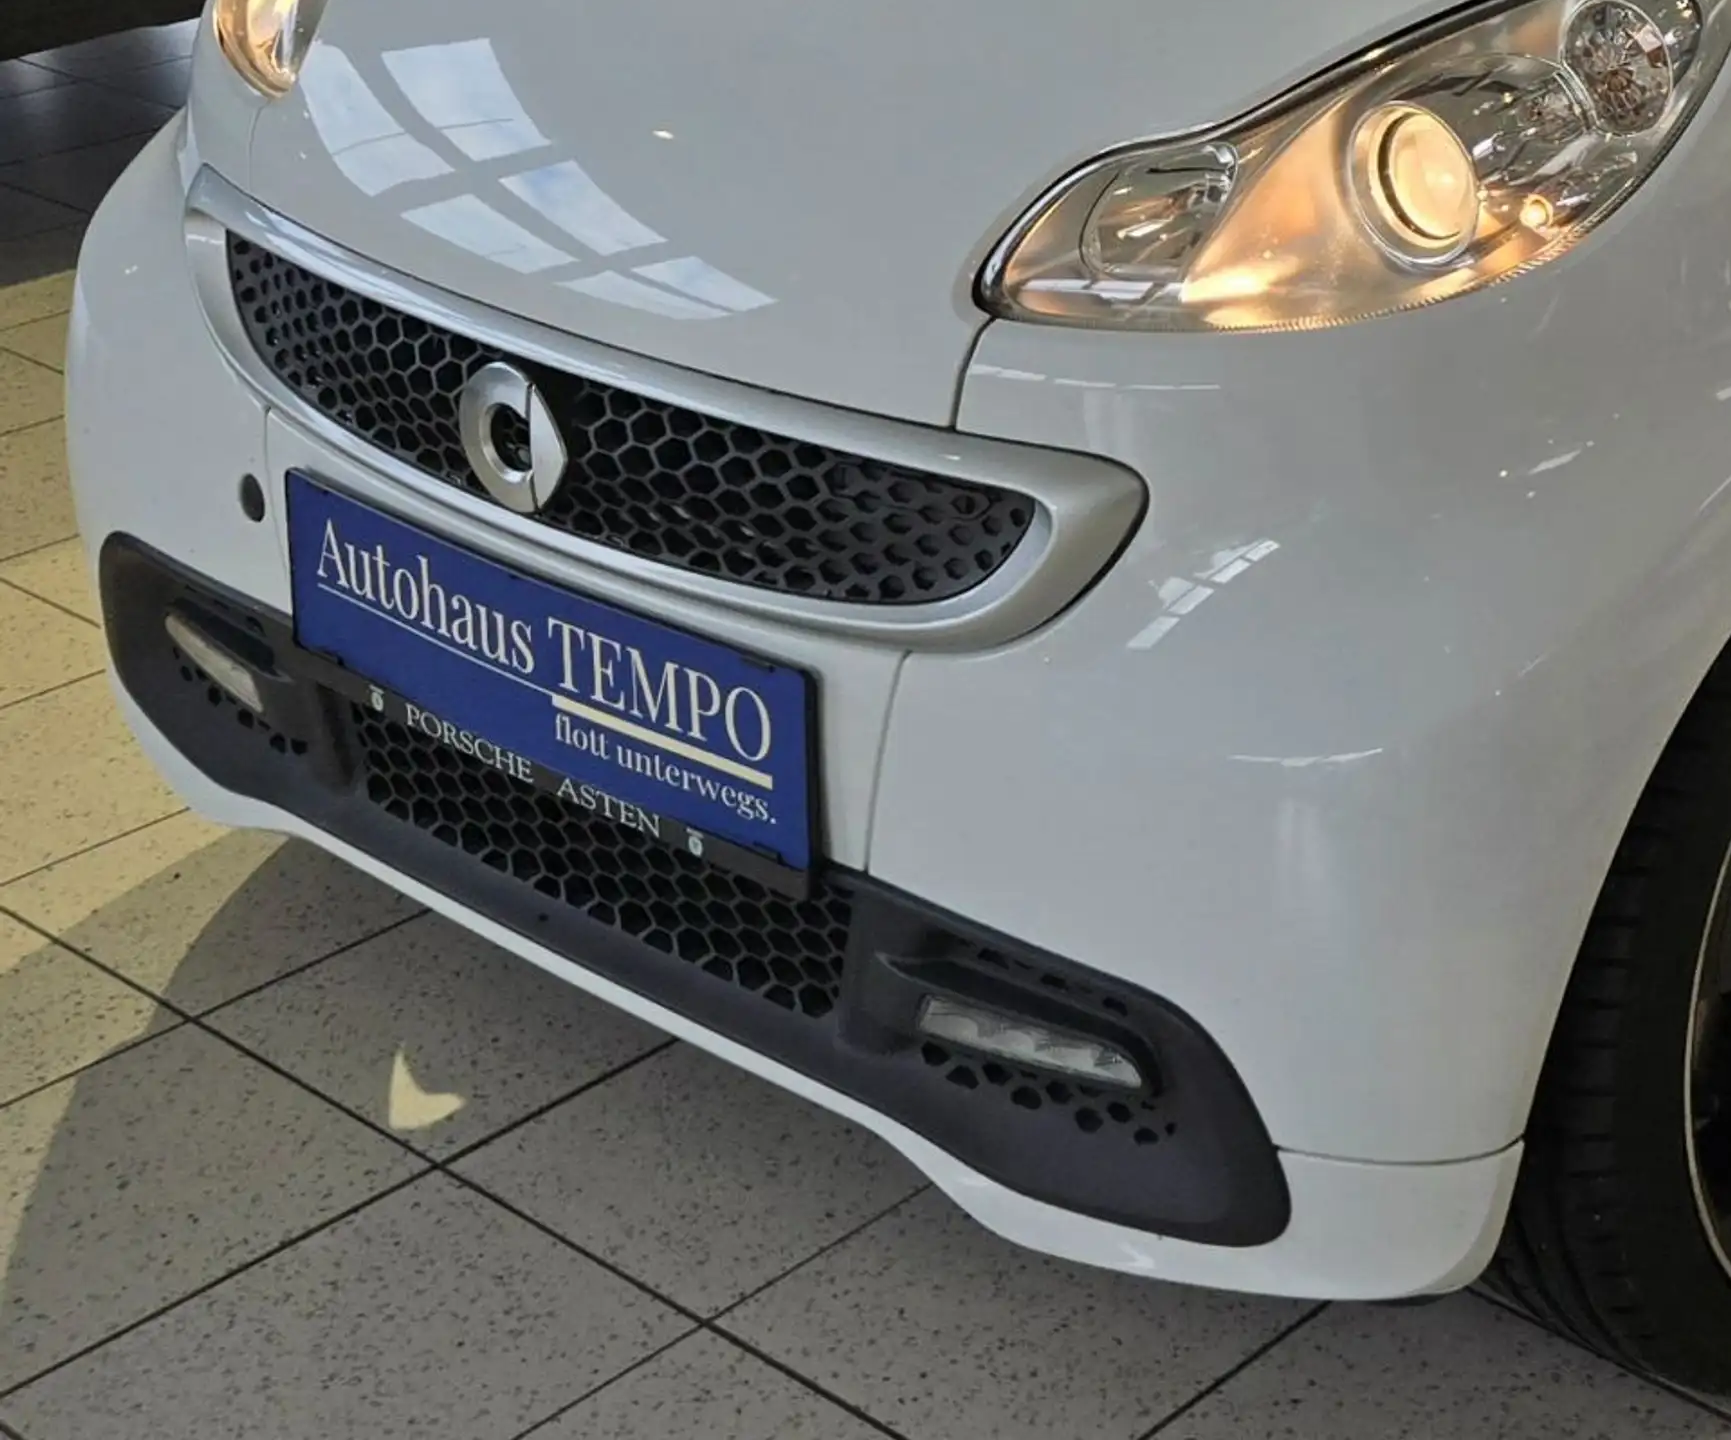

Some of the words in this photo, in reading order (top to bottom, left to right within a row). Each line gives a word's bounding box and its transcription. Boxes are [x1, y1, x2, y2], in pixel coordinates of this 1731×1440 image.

[317, 519, 534, 674] Autohaus
[548, 617, 772, 762] TEMPO
[405, 702, 534, 783] PORSCHE
[556, 777, 661, 839] ASTEN
[555, 713, 610, 760] flott
[617, 744, 778, 824] unterwegs.
